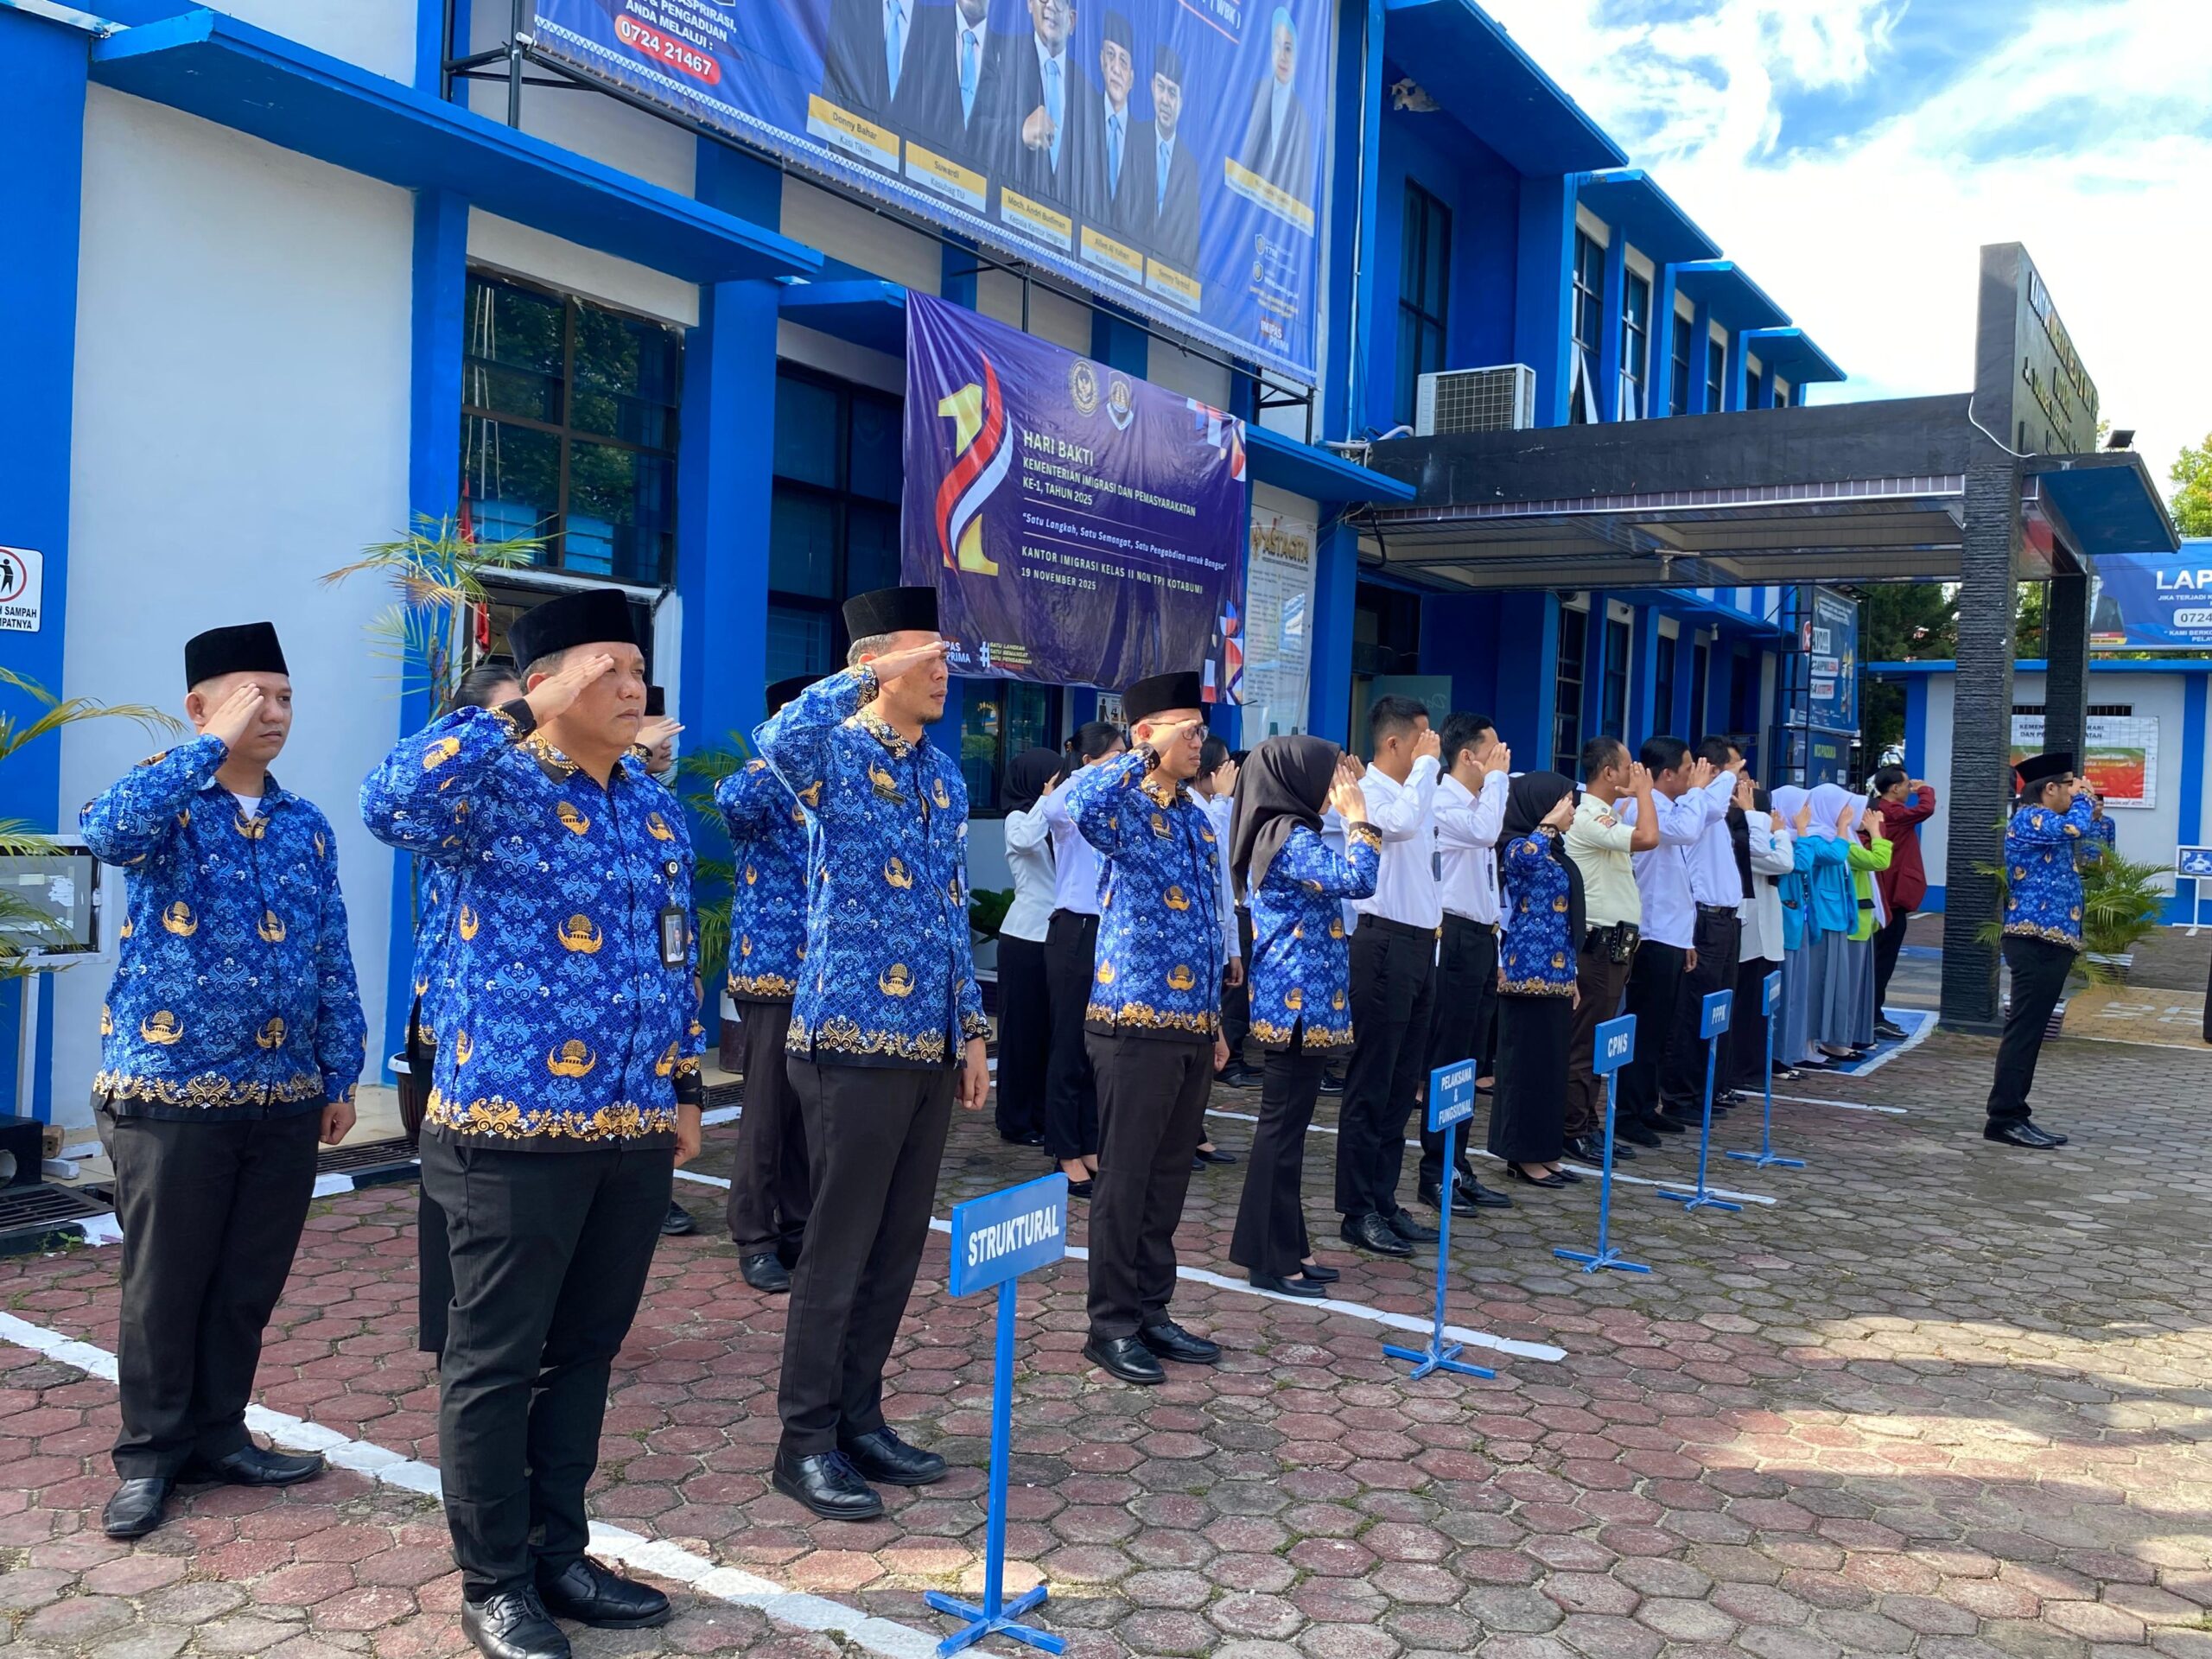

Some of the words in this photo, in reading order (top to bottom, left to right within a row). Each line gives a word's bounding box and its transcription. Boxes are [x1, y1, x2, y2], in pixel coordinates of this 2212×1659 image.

[626, 0, 657, 23] ANDA
[659, 15, 707, 48] MELALUI
[661, 0, 727, 41] PENGADUAN
[621, 20, 660, 52] 0724
[664, 41, 712, 76] 21467
[832, 111, 855, 131] Donny
[857, 123, 877, 140] Bahar
[1023, 430, 1055, 455] HARI
[1058, 441, 1093, 467] BAKTI
[1023, 456, 1081, 484] KEMENTERIAN
[1082, 474, 1117, 494] IMIGRASI
[1117, 485, 1133, 499] DAN
[1135, 490, 1196, 517] PEMASYARAKATAN
[1023, 476, 1044, 495] KE-1,
[1045, 482, 1073, 500] TAHUN
[1074, 491, 1093, 505] 2025
[1046, 518, 1078, 537] Langkah,
[1080, 527, 1096, 539] Satu
[1098, 531, 1134, 550] Semangat,
[1135, 541, 1149, 552] Satu
[1150, 544, 1185, 562] Pengabdian
[1186, 554, 1204, 565] untuk
[1021, 545, 1058, 563] KANTOR
[1060, 554, 1099, 572] IMIGRASI
[1101, 563, 1125, 577] KELAS
[1128, 569, 1134, 580] II
[1136, 570, 1151, 584] NON
[1153, 575, 1165, 587] TPI
[1167, 579, 1203, 594] KOTABUMI
[1021, 567, 1031, 577] 19
[1033, 569, 1077, 587] NOVEMBER
[1078, 578, 1096, 590] 2025
[4, 606, 37, 618] SAMPAH
[1712, 1003, 1727, 1026] PPPK
[1607, 1033, 1628, 1058] CPNS
[1440, 1066, 1472, 1092] PELAKSANA
[1438, 1098, 1471, 1126] FUNGSIONAL
[968, 1204, 1059, 1267] STRUKTURAL
